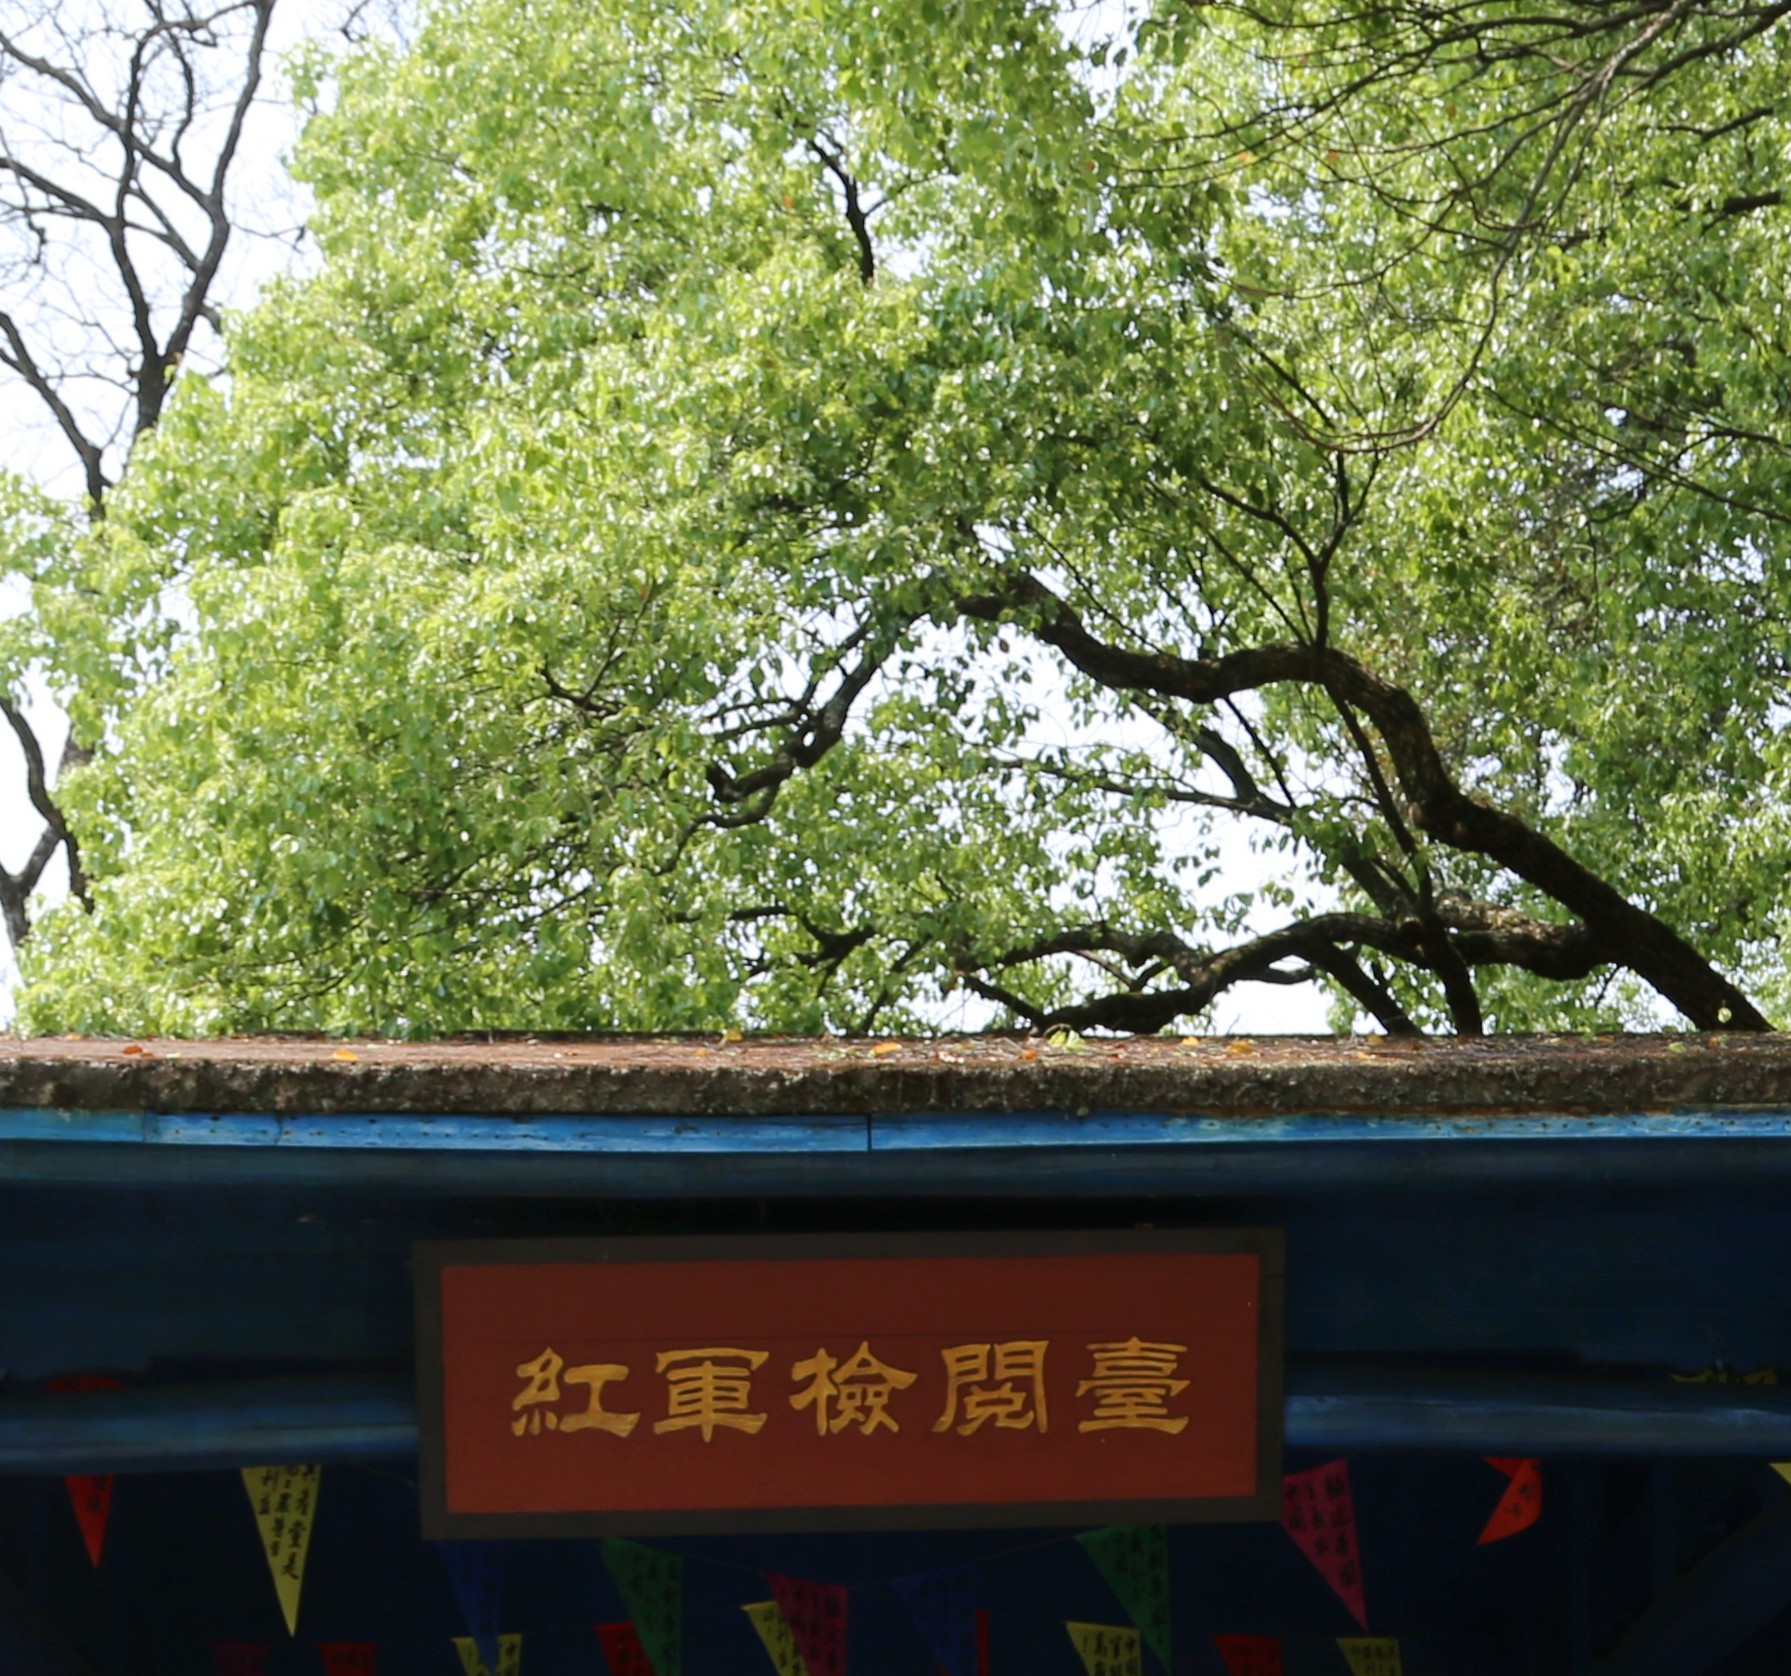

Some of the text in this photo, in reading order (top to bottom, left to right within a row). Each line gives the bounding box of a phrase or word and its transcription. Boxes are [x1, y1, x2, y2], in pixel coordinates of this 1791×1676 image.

[512, 1336, 1191, 1443] 紅軍檢閱臺
